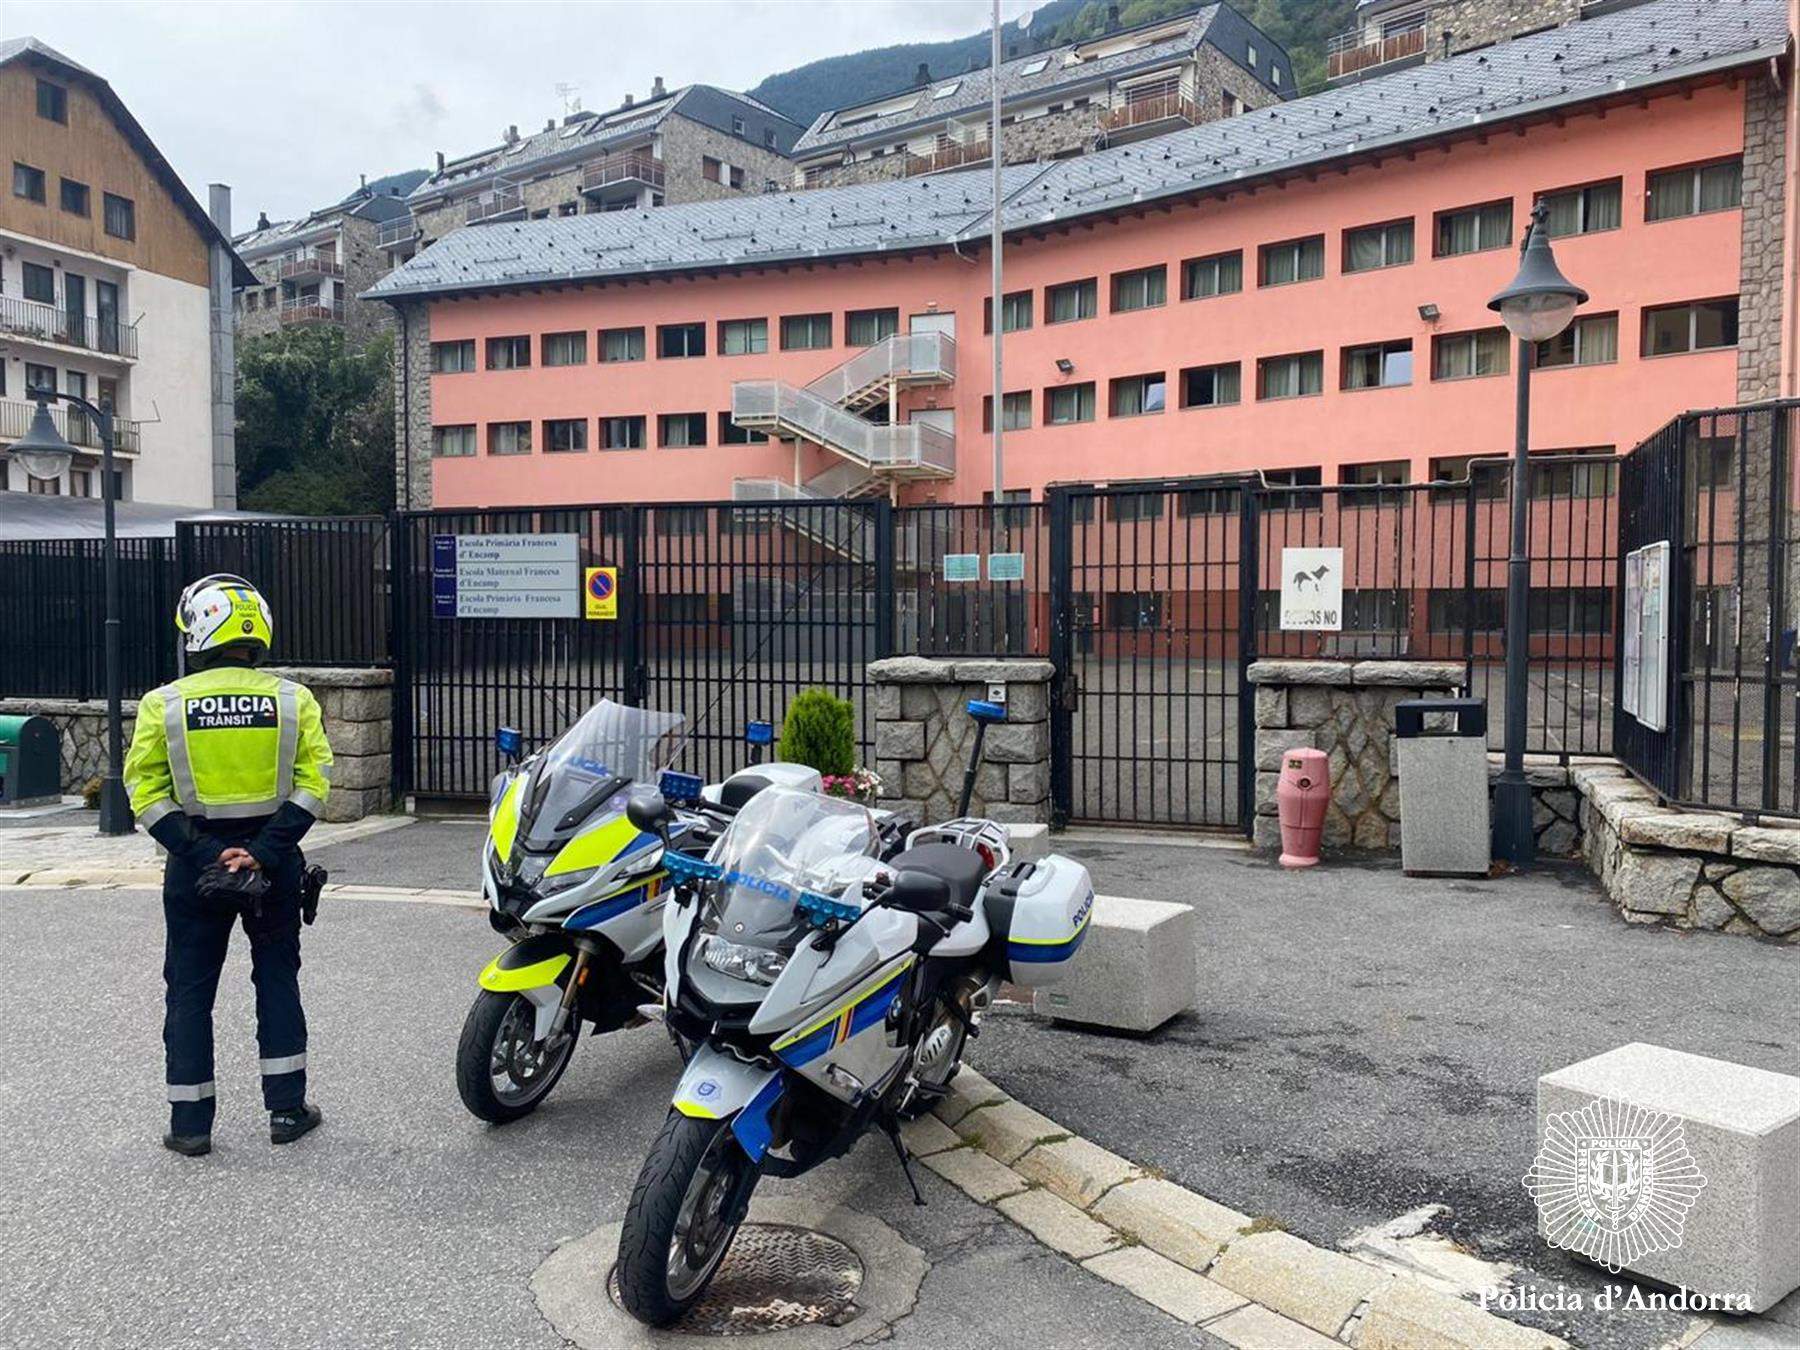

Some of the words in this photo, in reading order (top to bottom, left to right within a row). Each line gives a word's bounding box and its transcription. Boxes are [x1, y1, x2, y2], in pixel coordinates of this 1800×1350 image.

[458, 538, 484, 547] Escola
[522, 538, 558, 547] Francesa
[458, 567, 484, 576] Escola
[486, 567, 523, 576] Maternal
[524, 567, 560, 576] Francesa
[458, 594, 485, 603] Escola
[525, 594, 561, 603] Francesa
[1323, 610, 1338, 625] NO
[187, 696, 274, 715] POLICIA
[198, 714, 254, 727] TRÀNSIT
